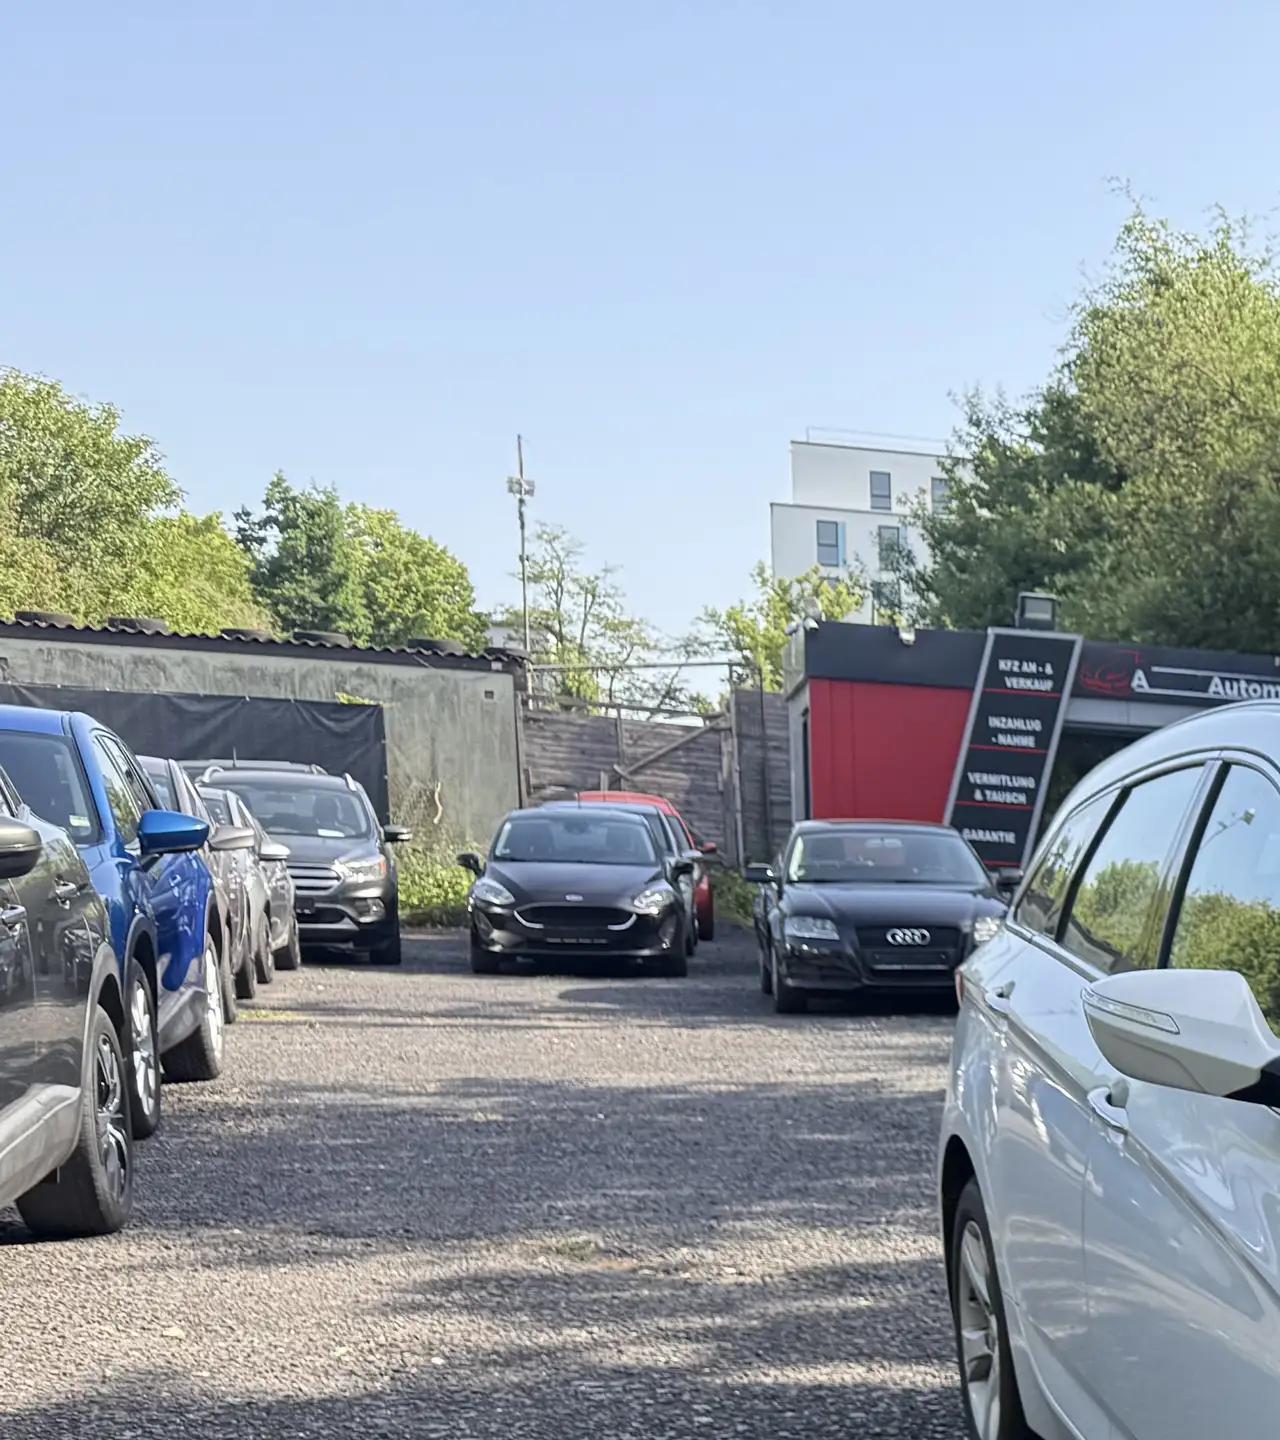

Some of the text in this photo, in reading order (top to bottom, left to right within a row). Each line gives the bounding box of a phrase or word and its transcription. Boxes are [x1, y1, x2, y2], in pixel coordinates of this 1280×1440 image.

[1004, 676, 1054, 691] VERKAUF
[984, 789, 1027, 805] TAUSCH
[962, 828, 1016, 844] GARANTIE
